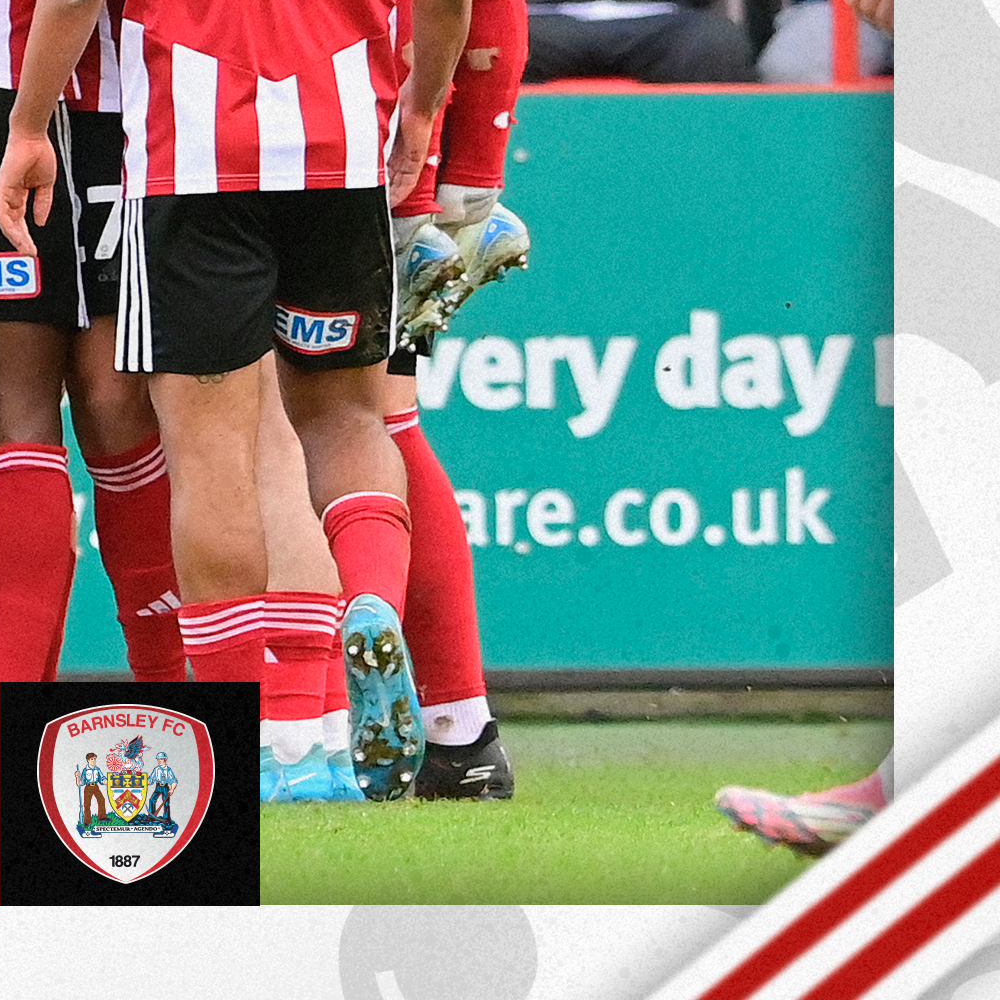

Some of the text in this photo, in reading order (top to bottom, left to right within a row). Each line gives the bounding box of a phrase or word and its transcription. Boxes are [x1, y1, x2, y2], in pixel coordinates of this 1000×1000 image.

[274, 306, 348, 344] EMS
[415, 334, 638, 439] very
[653, 309, 855, 438] day
[453, 466, 837, 547] are.co.uk
